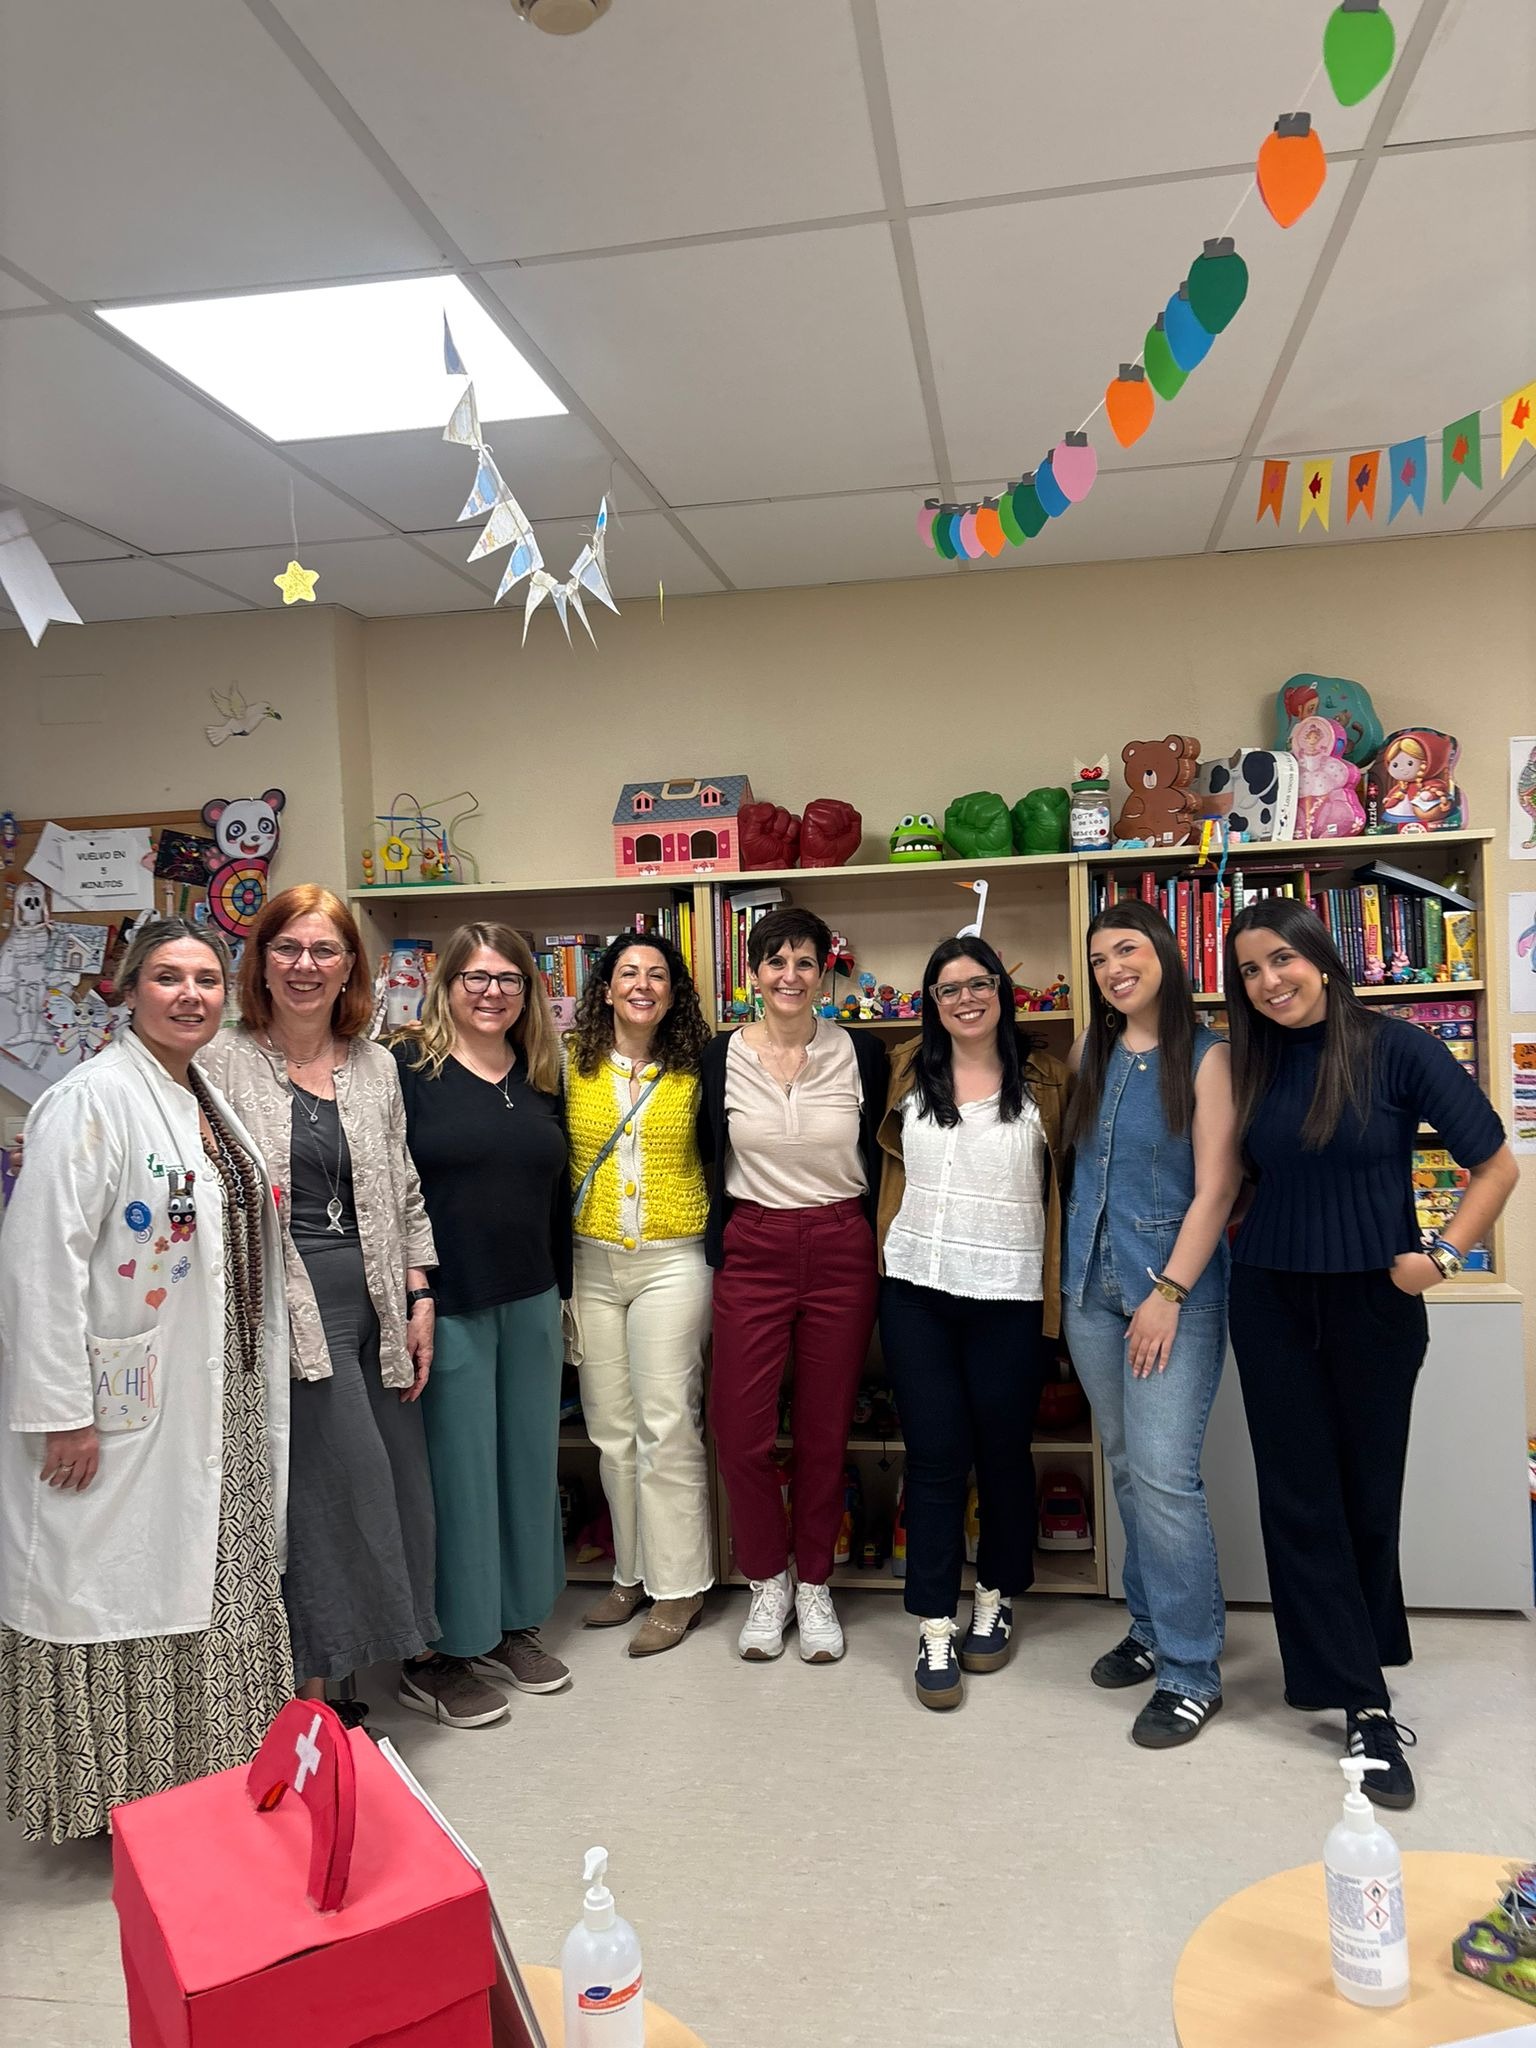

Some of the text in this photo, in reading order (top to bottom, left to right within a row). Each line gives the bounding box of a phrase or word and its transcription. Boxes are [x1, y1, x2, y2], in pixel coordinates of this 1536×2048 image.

[1368, 801, 1378, 835] Puzzle
[76, 850, 126, 860] VUELVO EN
[101, 867, 107, 875] 5
[80, 880, 123, 889] MINUTOS
[96, 1354, 159, 1409] ACHER
